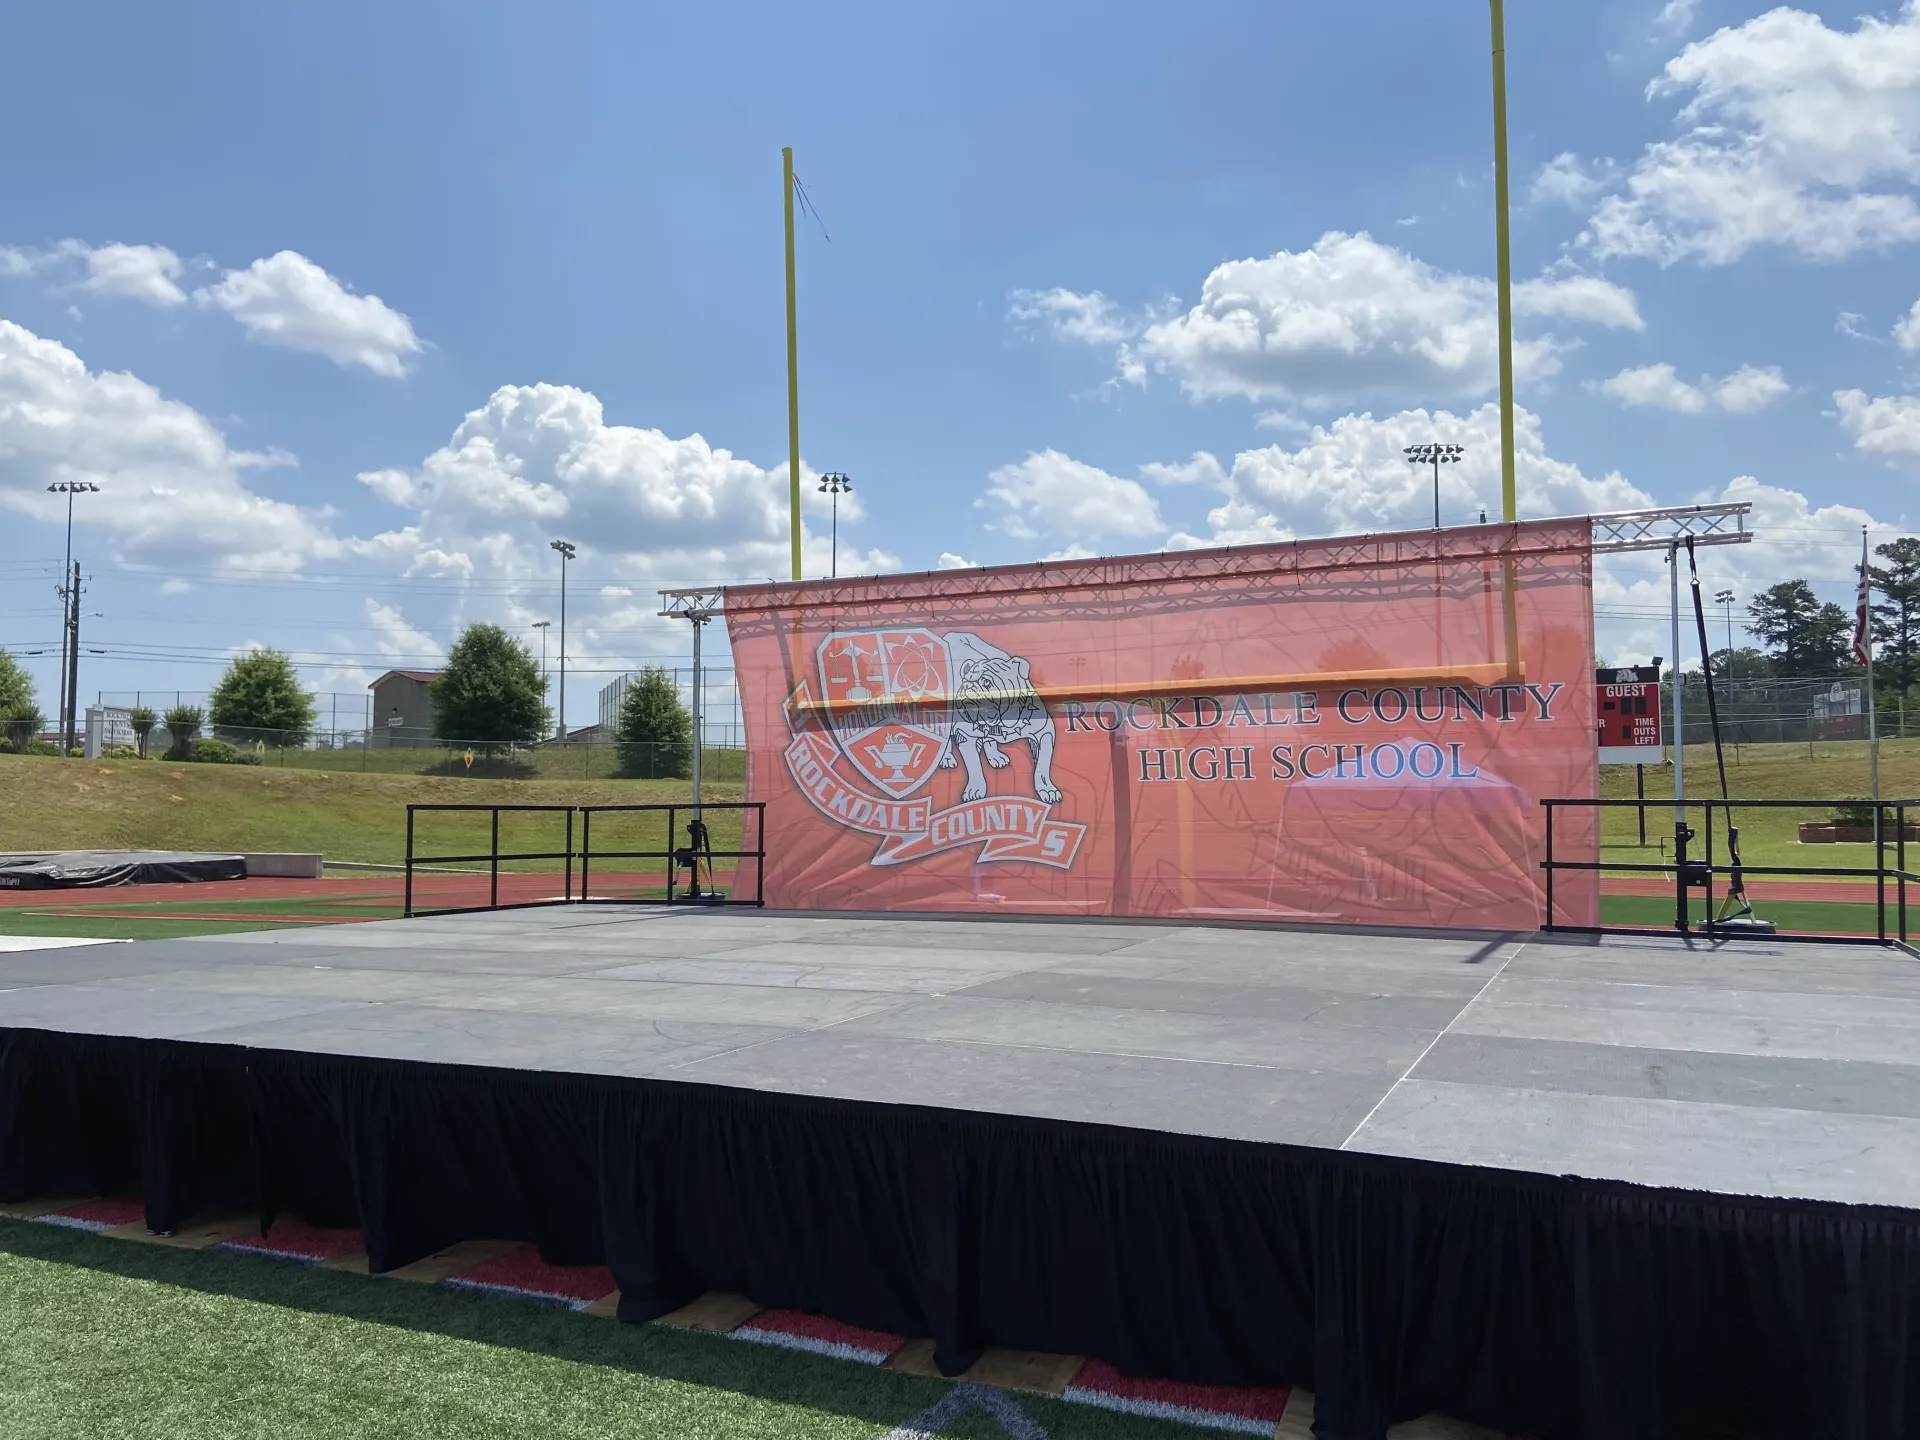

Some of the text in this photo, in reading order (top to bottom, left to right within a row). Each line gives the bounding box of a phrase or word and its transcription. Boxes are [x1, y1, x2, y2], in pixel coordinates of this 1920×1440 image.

[1606, 685, 1647, 697] GUEST
[1065, 683, 1566, 733] ROCKDALE COUNTY
[1598, 719, 1605, 727] R
[1634, 718, 1655, 726] TIME
[1633, 727, 1656, 736] OUTS
[1634, 736, 1655, 745] LEFT
[1138, 742, 1480, 782] HIGH SCHOOL
[790, 740, 1069, 857] ROCKDALE COUNTY S
